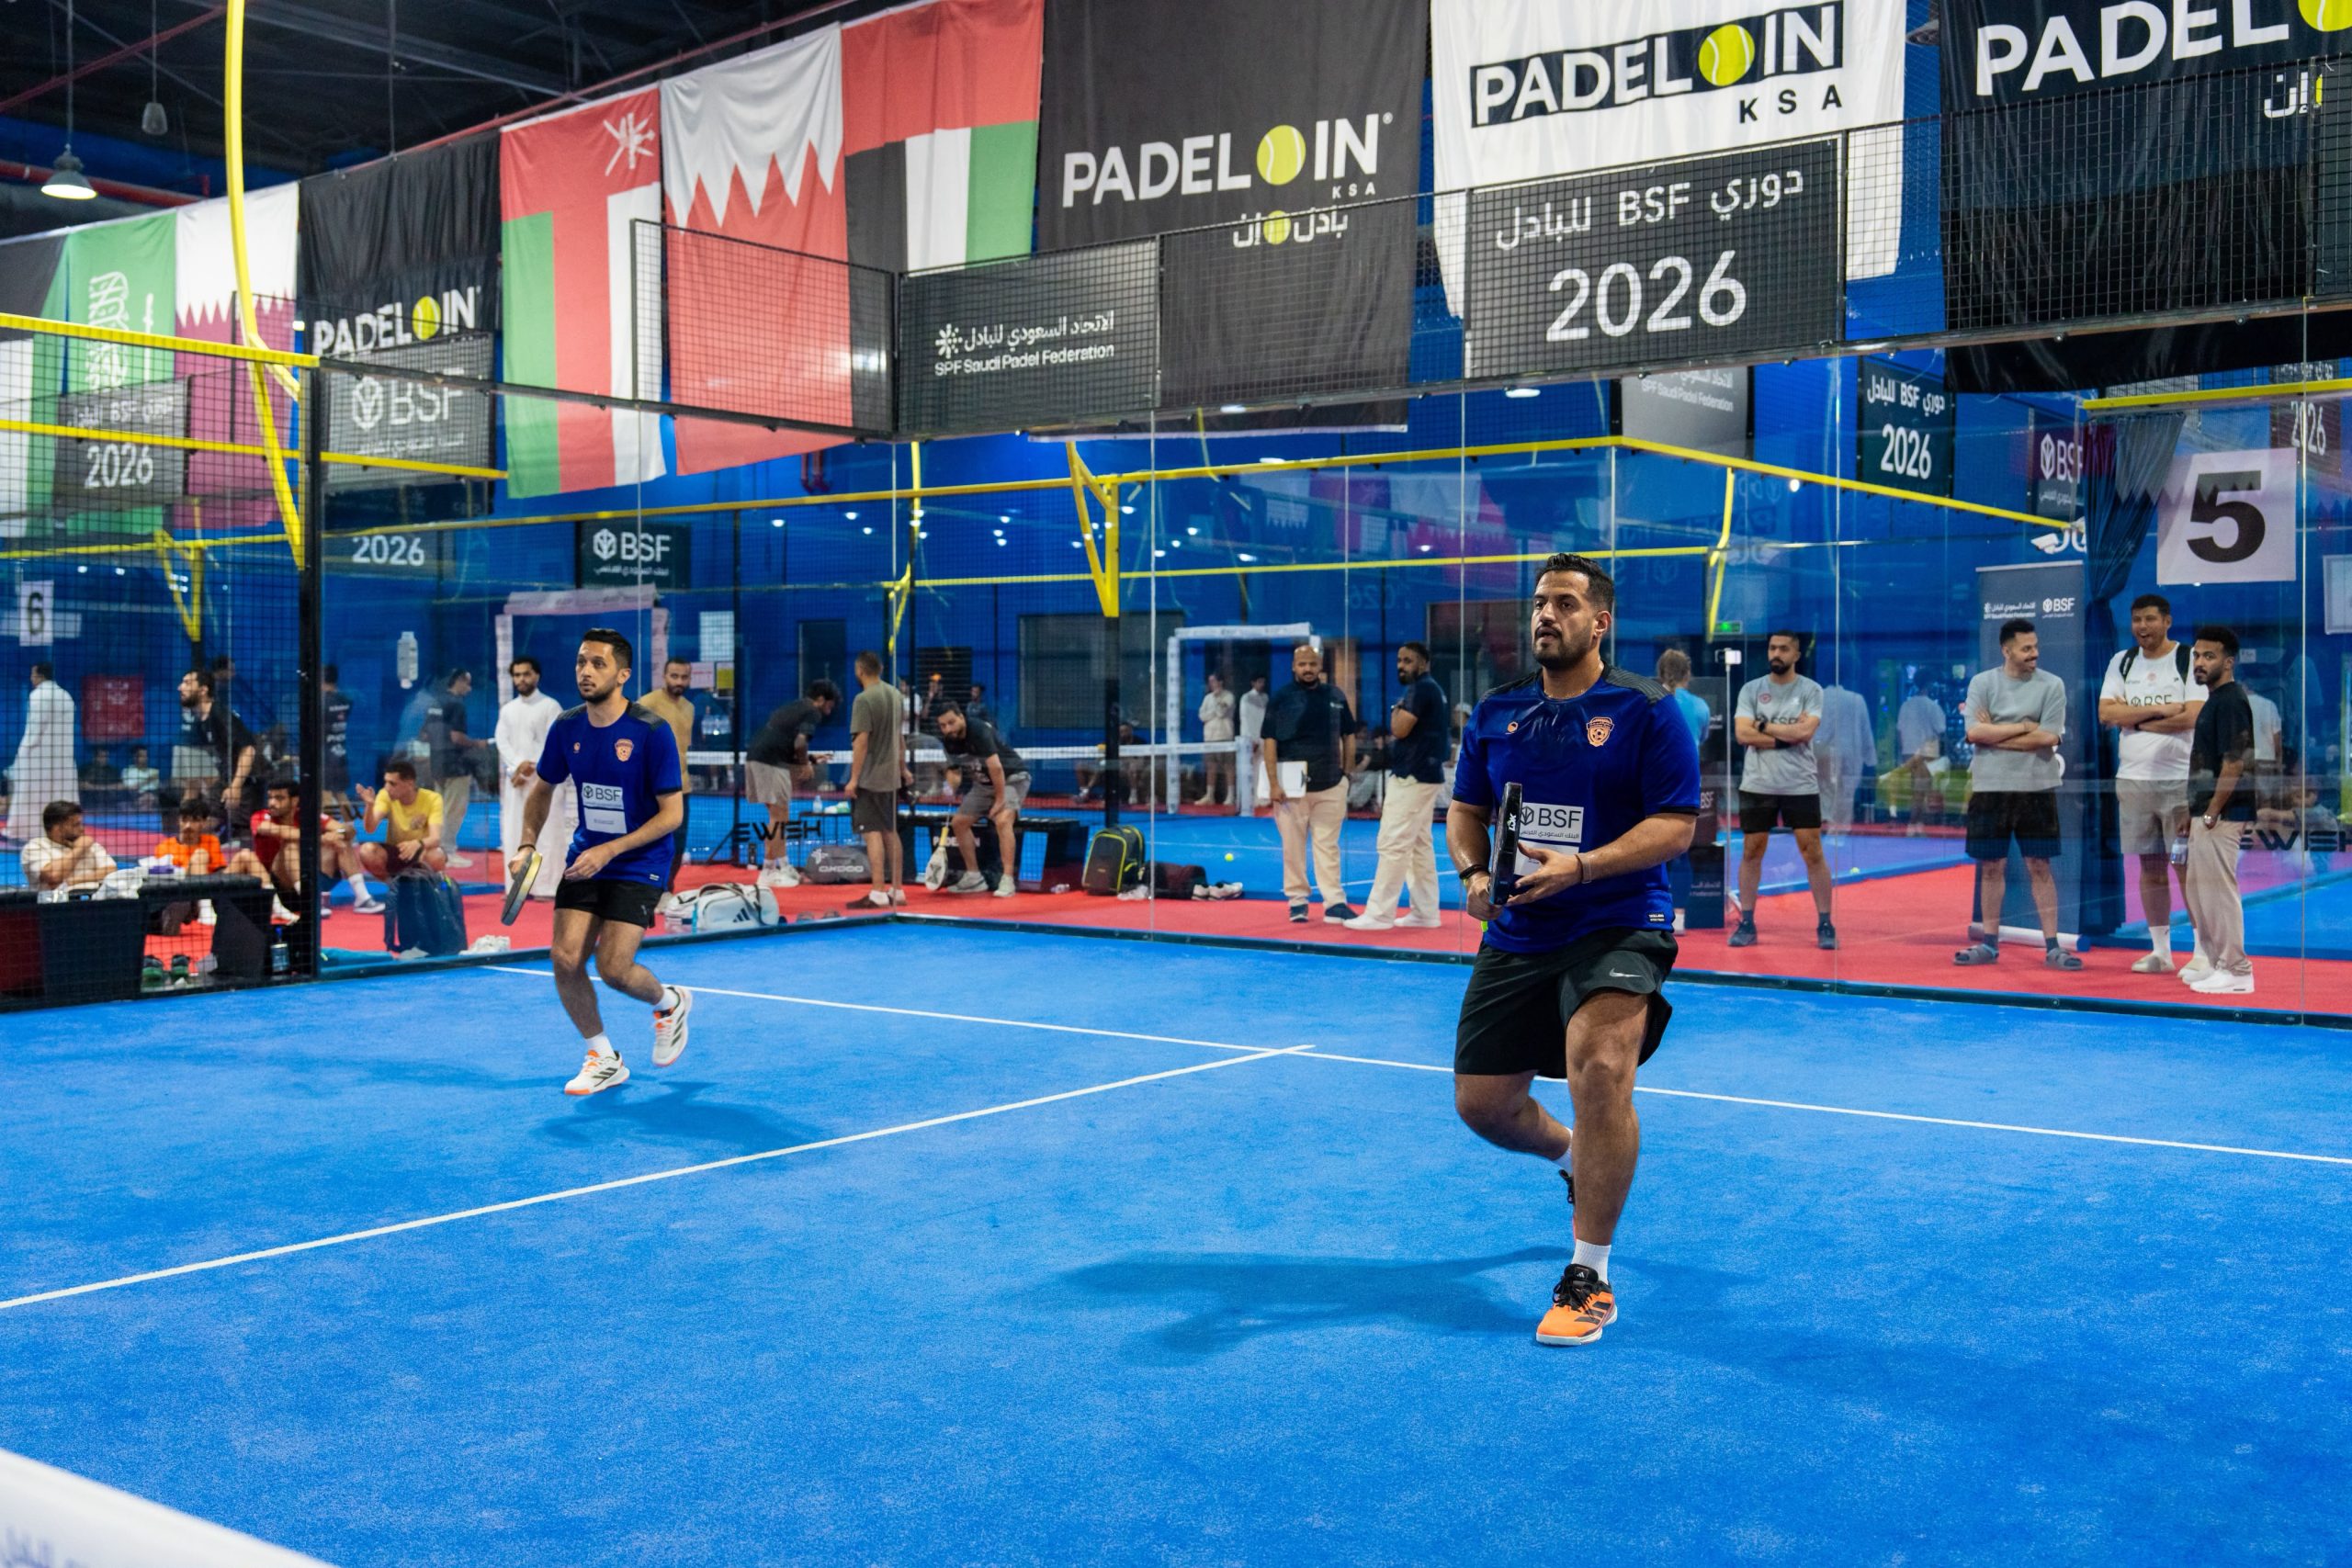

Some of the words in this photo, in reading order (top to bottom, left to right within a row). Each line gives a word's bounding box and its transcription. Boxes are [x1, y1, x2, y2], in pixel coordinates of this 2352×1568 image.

[1977, 0, 2290, 96] PADEL
[1618, 181, 1691, 227] BSF
[1711, 169, 1804, 221] دوري
[1496, 196, 1591, 250] للبادل
[1545, 249, 1747, 343] 2026
[1007, 315, 1068, 353] السعودي
[934, 360, 963, 377] SPF
[964, 355, 1001, 373] Saudi
[1001, 351, 1039, 370] Padel
[1042, 344, 1114, 366] Federation
[1900, 381, 1921, 409] BSF
[85, 443, 153, 489] 2026
[1880, 423, 1932, 480] 2026
[2187, 469, 2266, 563] 5
[352, 534, 425, 568] 2026
[620, 531, 673, 563] BSF
[28, 592, 45, 636] 6
[2052, 597, 2075, 613] BSF
[595, 787, 621, 801] BSF
[1538, 807, 1582, 829] BSF
